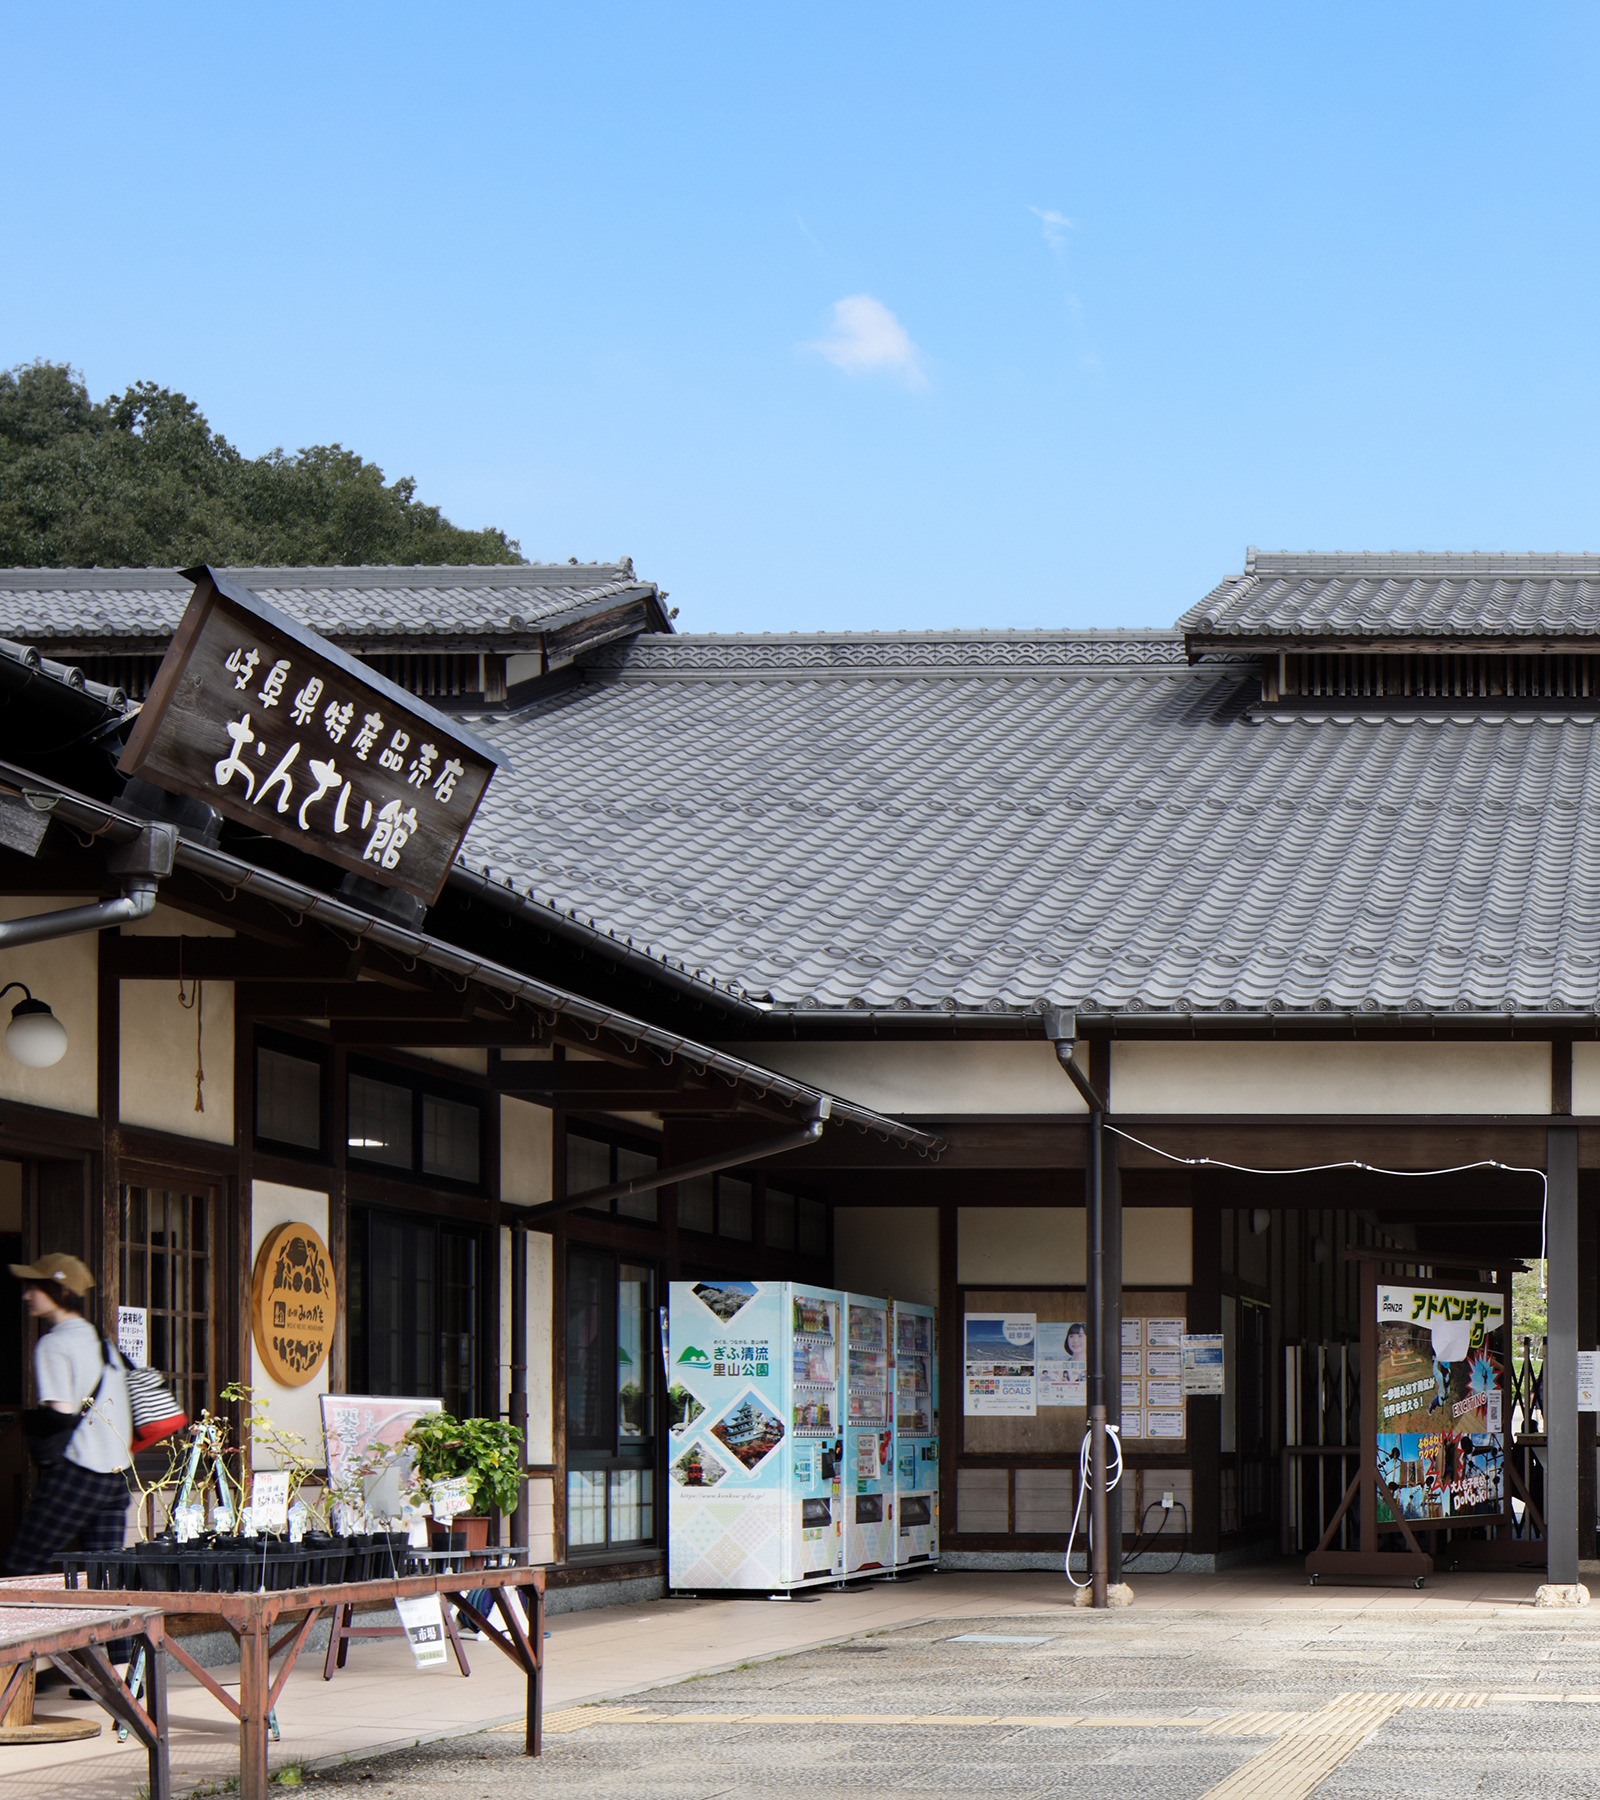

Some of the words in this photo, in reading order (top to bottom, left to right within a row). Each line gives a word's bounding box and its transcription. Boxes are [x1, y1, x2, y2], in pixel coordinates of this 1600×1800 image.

[225, 648, 464, 803] 岐阜県特産品売店
[215, 714, 418, 869] おんさい館
[1383, 1303, 1403, 1312] PANZA
[1411, 1293, 1502, 1322] アドベンチャー
[713, 1346, 769, 1361] ぎふ清流
[713, 1363, 769, 1377] 里山公園
[1002, 1387, 1032, 1395] GOALS
[1381, 1377, 1435, 1401] 一歩踏み出す勇気が
[1452, 1391, 1487, 1418] EXCITING
[1418, 1446, 1439, 1460] ワクワク
